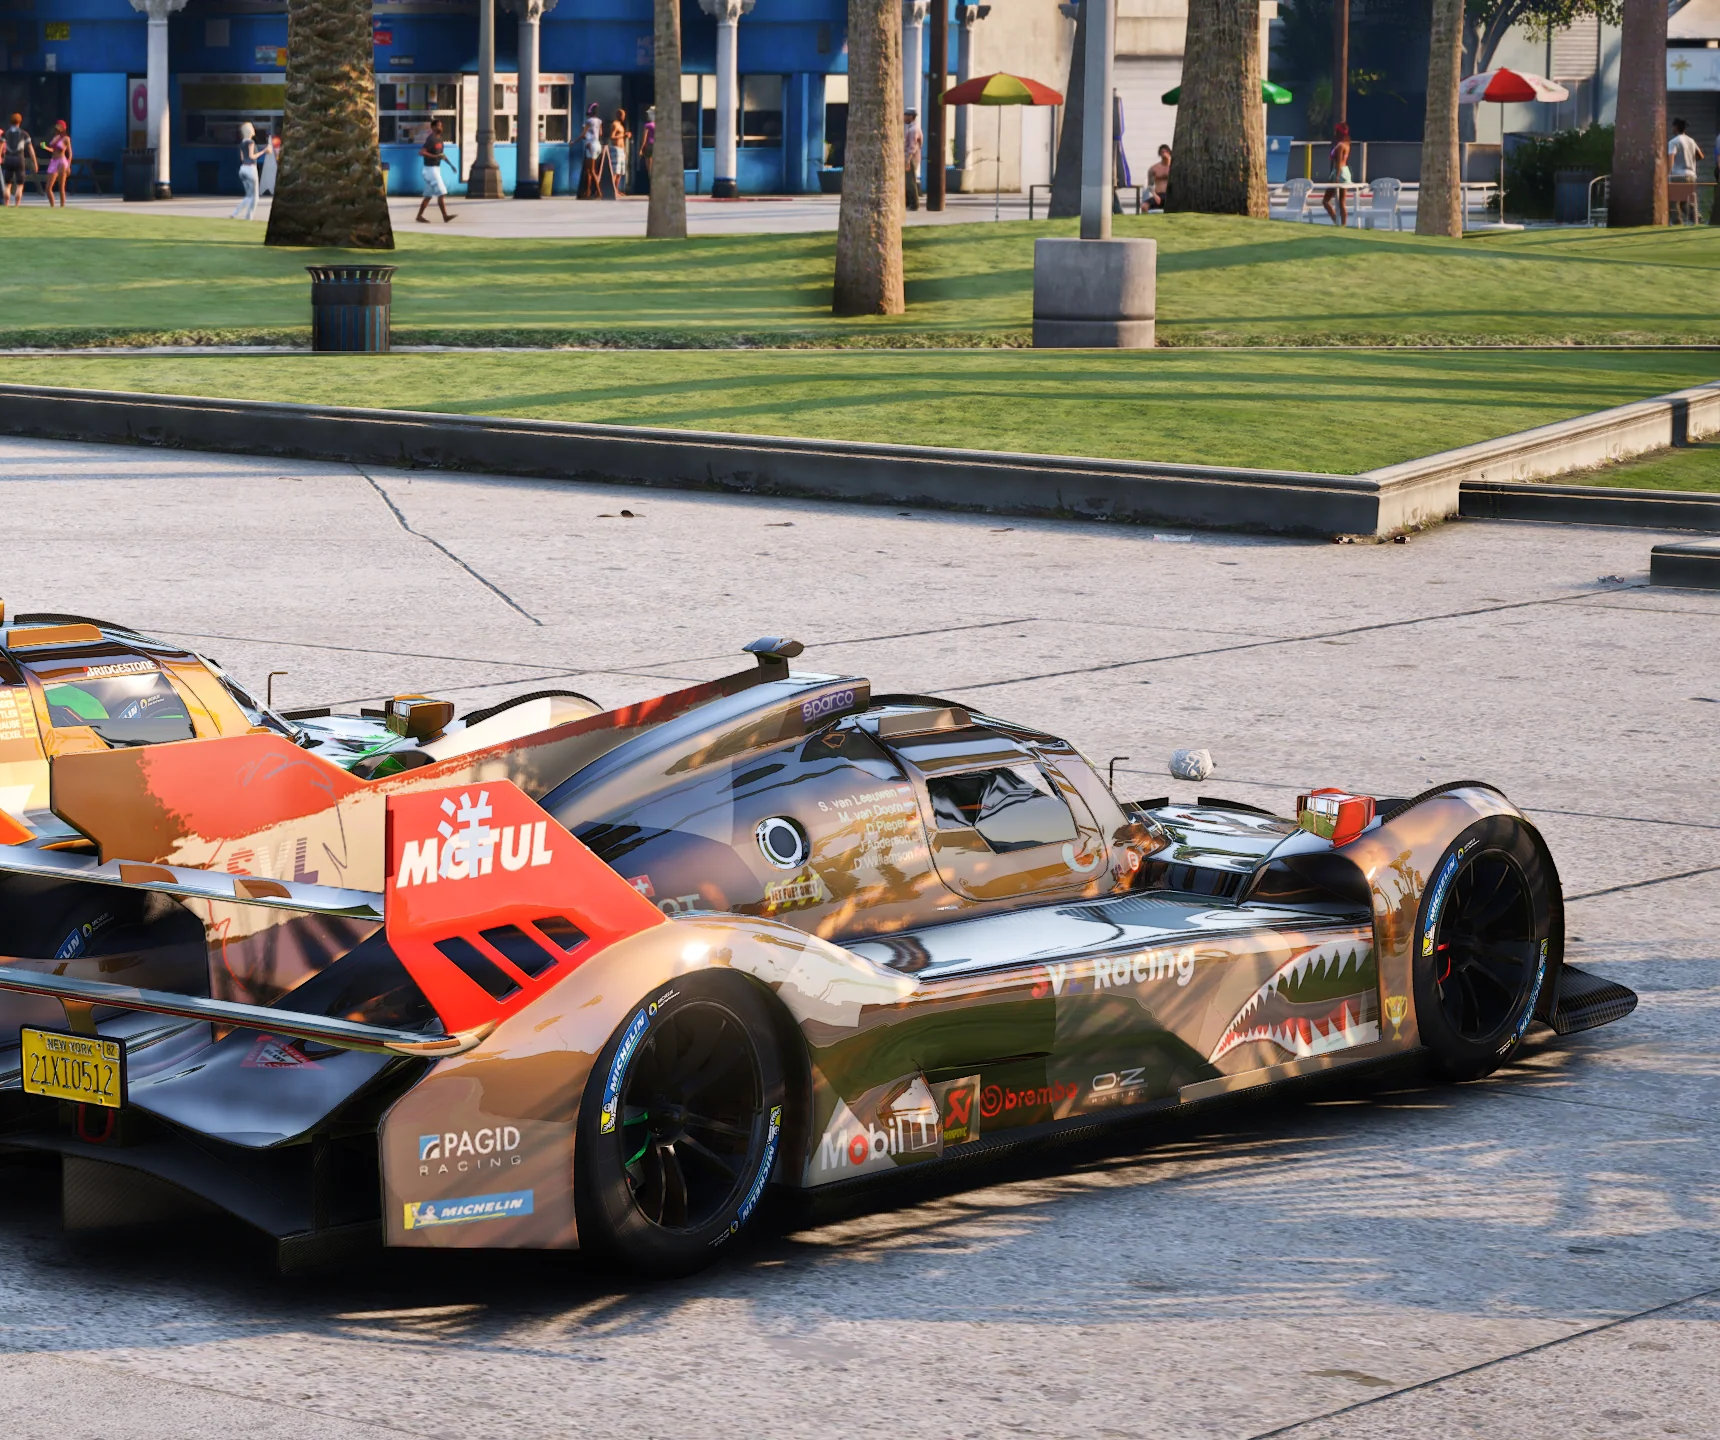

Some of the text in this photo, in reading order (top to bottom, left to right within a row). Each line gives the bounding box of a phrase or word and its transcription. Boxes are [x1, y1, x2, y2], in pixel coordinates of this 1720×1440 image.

[83, 660, 156, 678] BRIDGESTONE
[803, 690, 854, 721] sparco
[817, 788, 898, 813] S. van Leeuwen
[1429, 858, 1455, 922] MICHELIN
[1093, 945, 1197, 990] Racing
[46, 1038, 93, 1057] NEW YORK
[610, 1014, 646, 1093] MICHELIN
[1004, 1079, 1078, 1112] brembo
[444, 1126, 521, 1158] PAGID
[821, 1113, 904, 1171] Mobil
[419, 1155, 522, 1177] RACING
[742, 1145, 775, 1221] MICHELIN
[441, 1198, 524, 1217] MICHELIN
